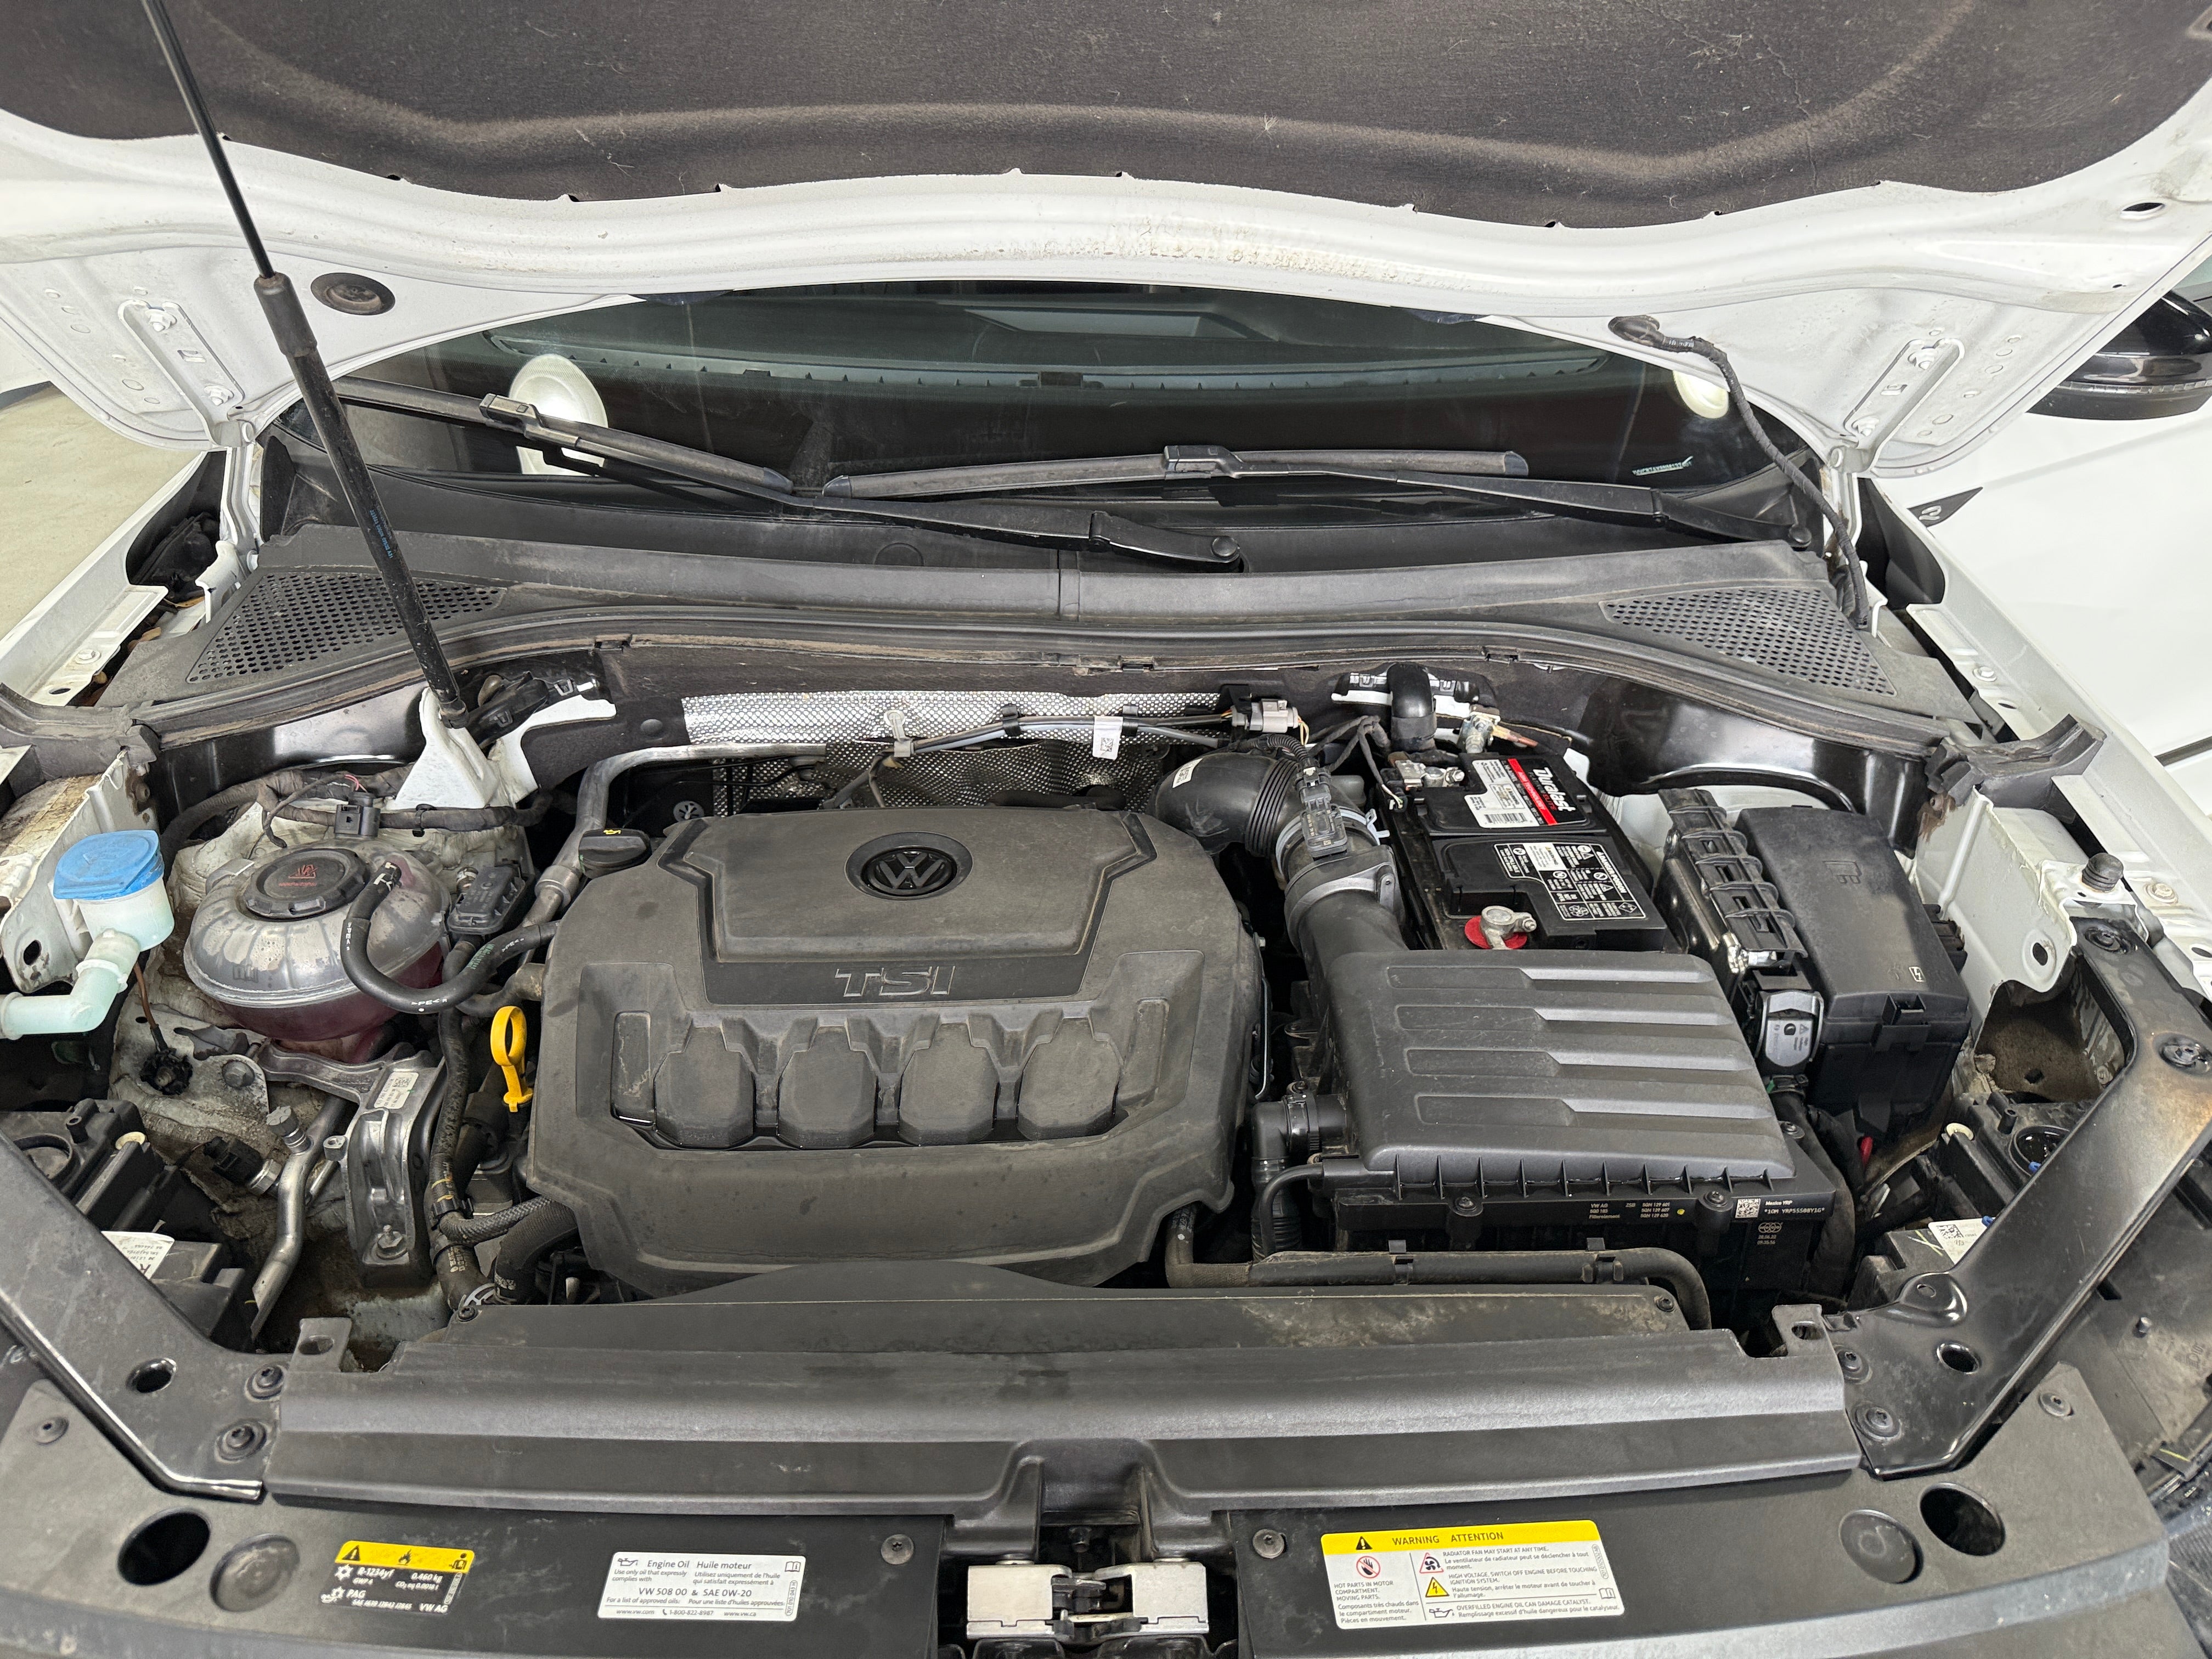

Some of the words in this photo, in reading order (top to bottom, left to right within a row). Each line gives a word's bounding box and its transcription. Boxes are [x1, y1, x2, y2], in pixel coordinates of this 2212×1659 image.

[1533, 767, 1576, 811] Duralast
[879, 852, 946, 889] VW
[1599, 855, 1615, 875] DANGER
[1611, 873, 1627, 893] POISON
[835, 966, 956, 997] TSI
[1392, 1536, 1440, 1545] WARNING
[1451, 1532, 1504, 1542] ATTENTION
[647, 1560, 675, 1569] Engine
[357, 1567, 395, 1579] R-1234yf
[411, 1572, 433, 1581] 0.460
[433, 1574, 443, 1584] kg
[346, 1589, 366, 1599] PAG
[419, 1603, 436, 1612] VW
[435, 1604, 448, 1613] AG
[1346, 1609, 1387, 1617] compartiment
